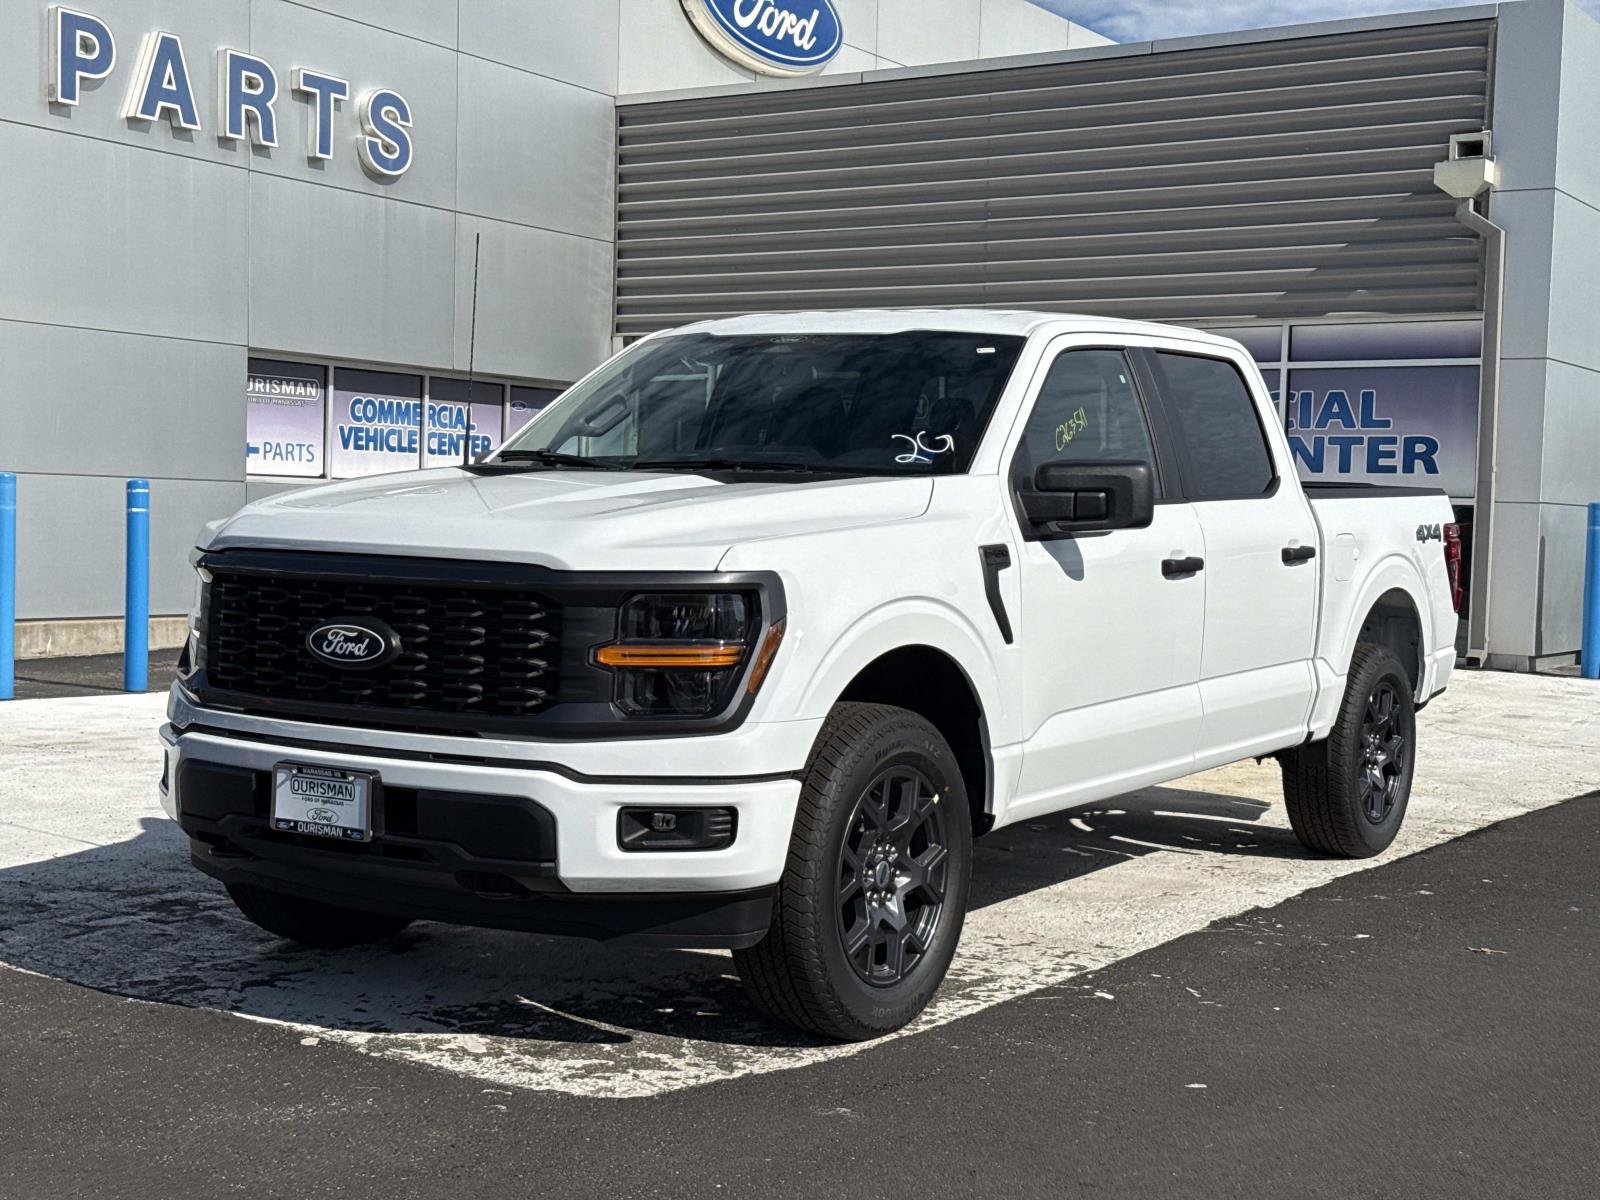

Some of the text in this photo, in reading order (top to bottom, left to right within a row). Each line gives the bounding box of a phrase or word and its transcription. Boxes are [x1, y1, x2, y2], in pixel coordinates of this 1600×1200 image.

[55, 6, 413, 176] PARTS
[349, 397, 477, 431] COMMERCIAL
[263, 441, 315, 463] PARTS
[339, 425, 492, 457] VEHICLE CENTER
[322, 629, 370, 656] Ford
[292, 779, 353, 799] OURISMAN
[311, 809, 334, 822] Ford
[297, 821, 343, 837] OURISMAN
